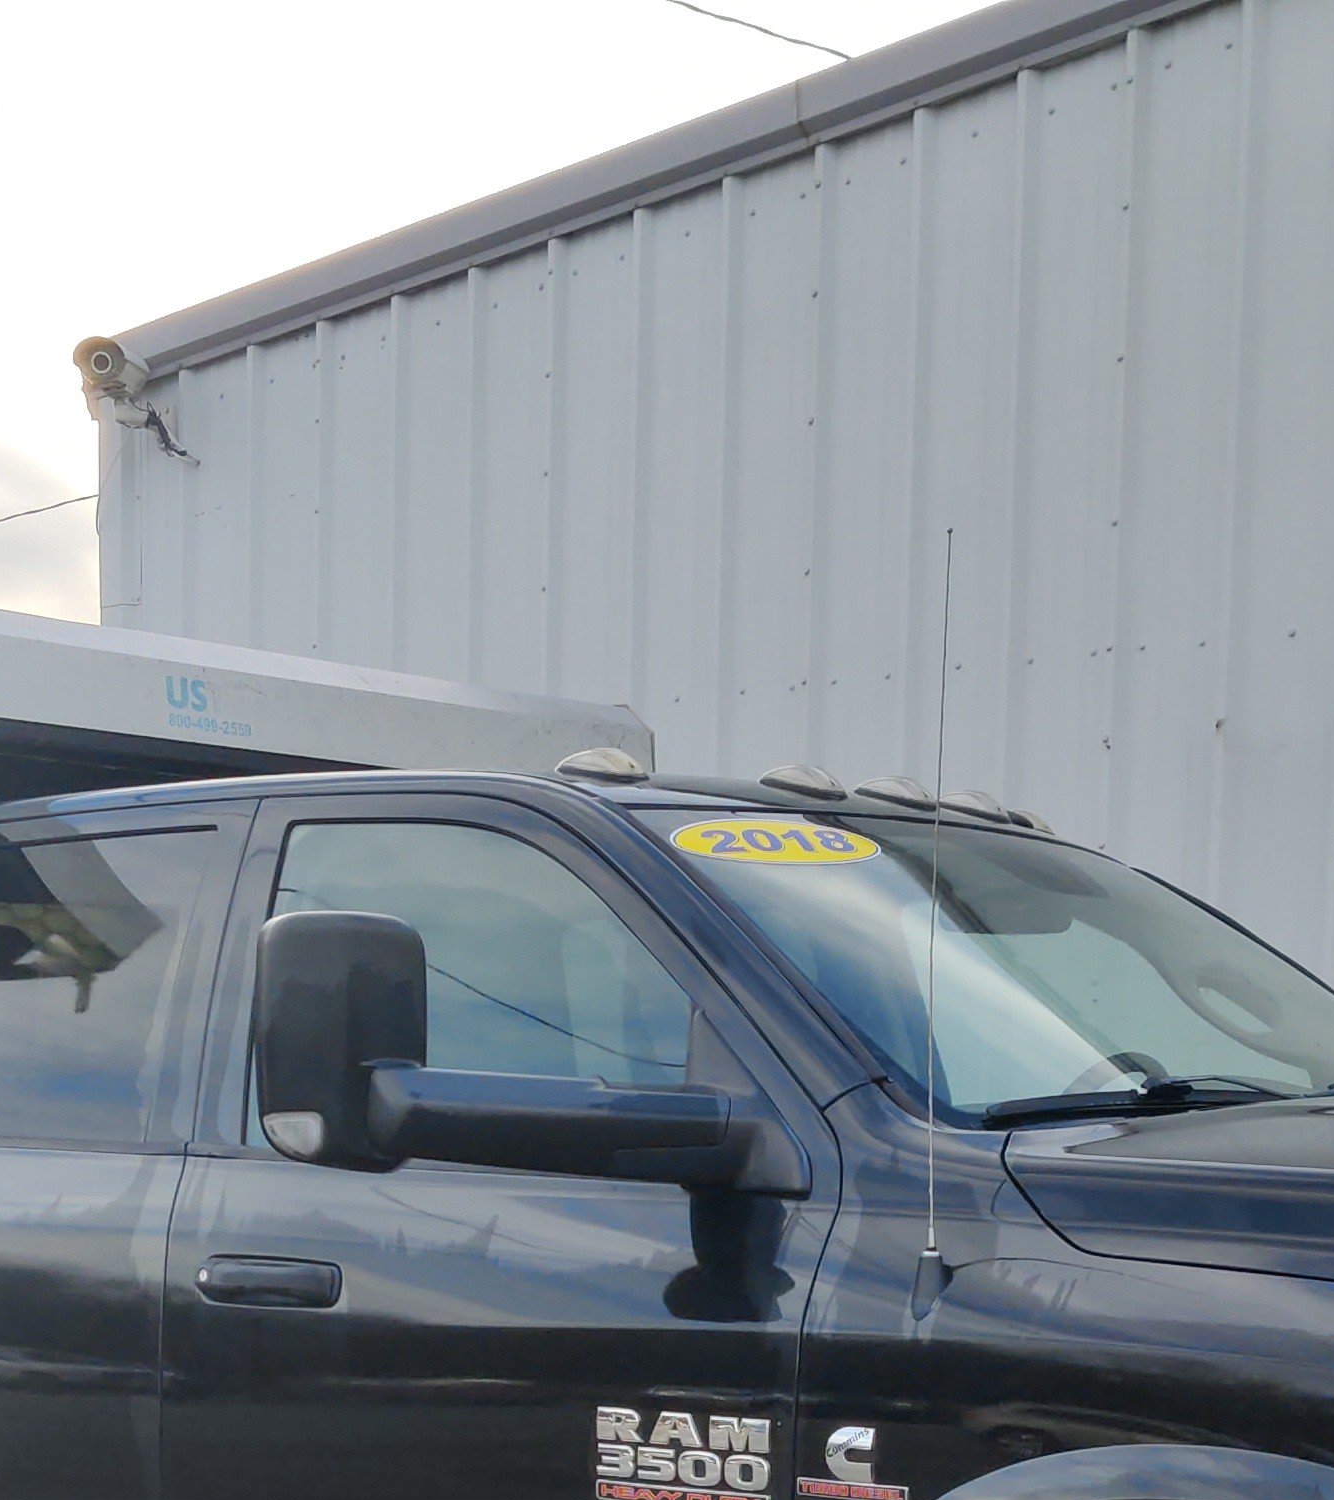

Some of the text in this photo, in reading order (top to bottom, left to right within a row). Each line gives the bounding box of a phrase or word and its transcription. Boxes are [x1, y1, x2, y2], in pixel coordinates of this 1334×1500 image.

[165, 676, 208, 712] US
[700, 829, 858, 854] 2018
[596, 1406, 772, 1453] RAM
[596, 1443, 772, 1491] 3500
[799, 1480, 849, 1497] TURBO
